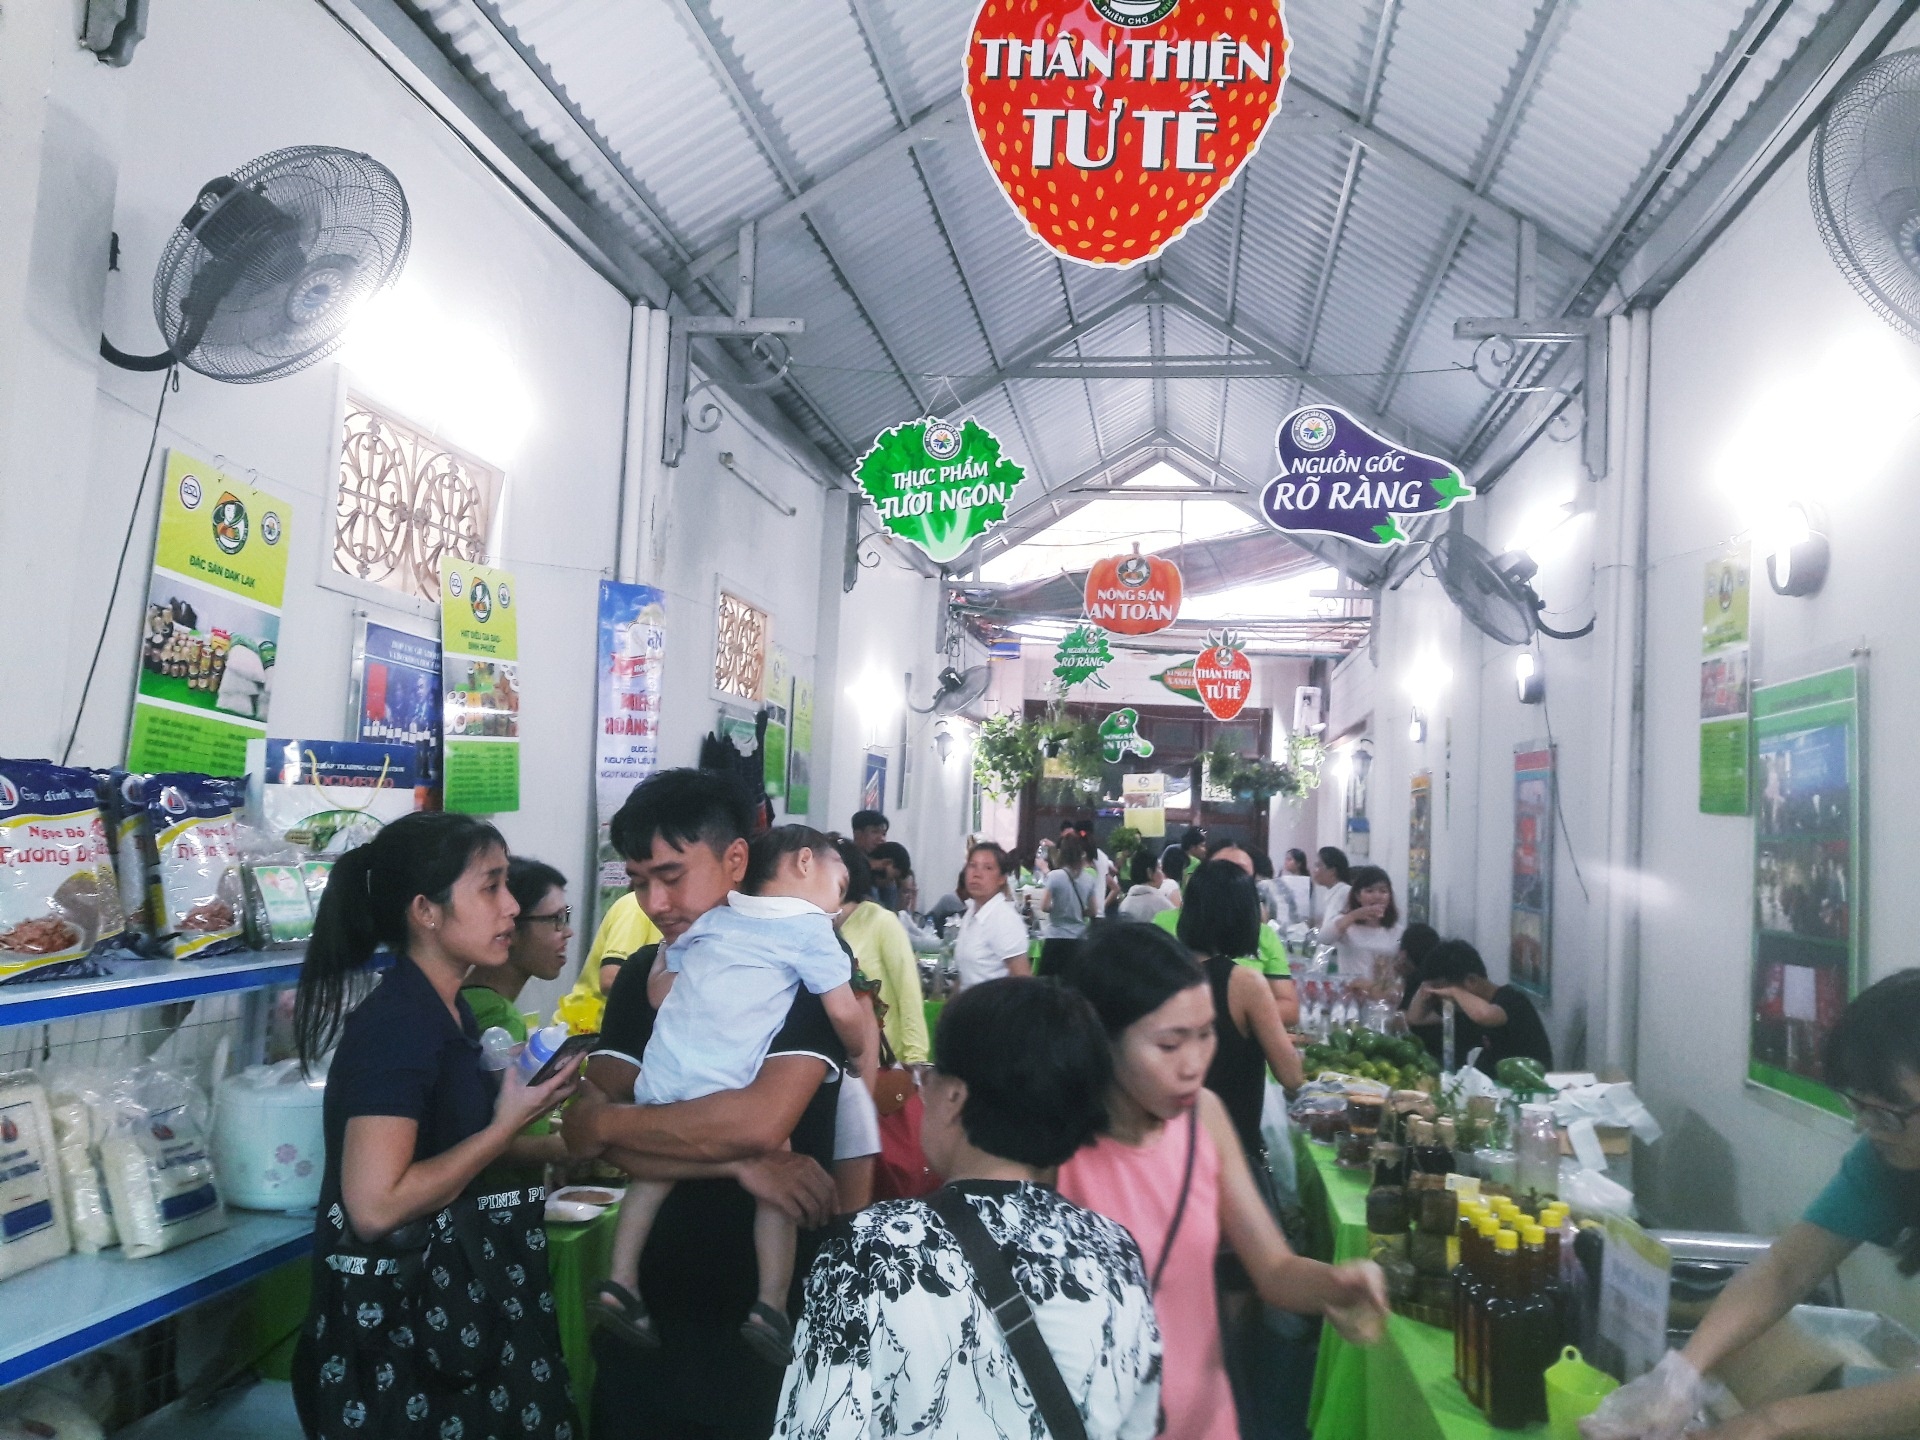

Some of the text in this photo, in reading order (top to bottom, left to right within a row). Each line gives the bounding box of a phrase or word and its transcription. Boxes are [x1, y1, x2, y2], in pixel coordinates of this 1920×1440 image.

[1101, 5, 1125, 23] PHIÊN
[1128, 15, 1149, 25] CHỢ
[979, 30, 1273, 88] THÂN THIỆN
[1022, 85, 1219, 172] TỬ TẾ
[1290, 449, 1406, 474] NGUỒN GỐC
[891, 455, 989, 492] THỰC PHẨM
[1273, 475, 1423, 510] RÕ RÀNG
[1097, 588, 1135, 600] NÔNG
[1090, 601, 1173, 620] AN TOÀN
[1061, 654, 1104, 667] RÕ RÀNG
[1197, 668, 1220, 679] THÂN
[1222, 668, 1250, 681] THIỆN
[1225, 681, 1242, 699] TẾ
[478, 1190, 521, 1211] PINK
